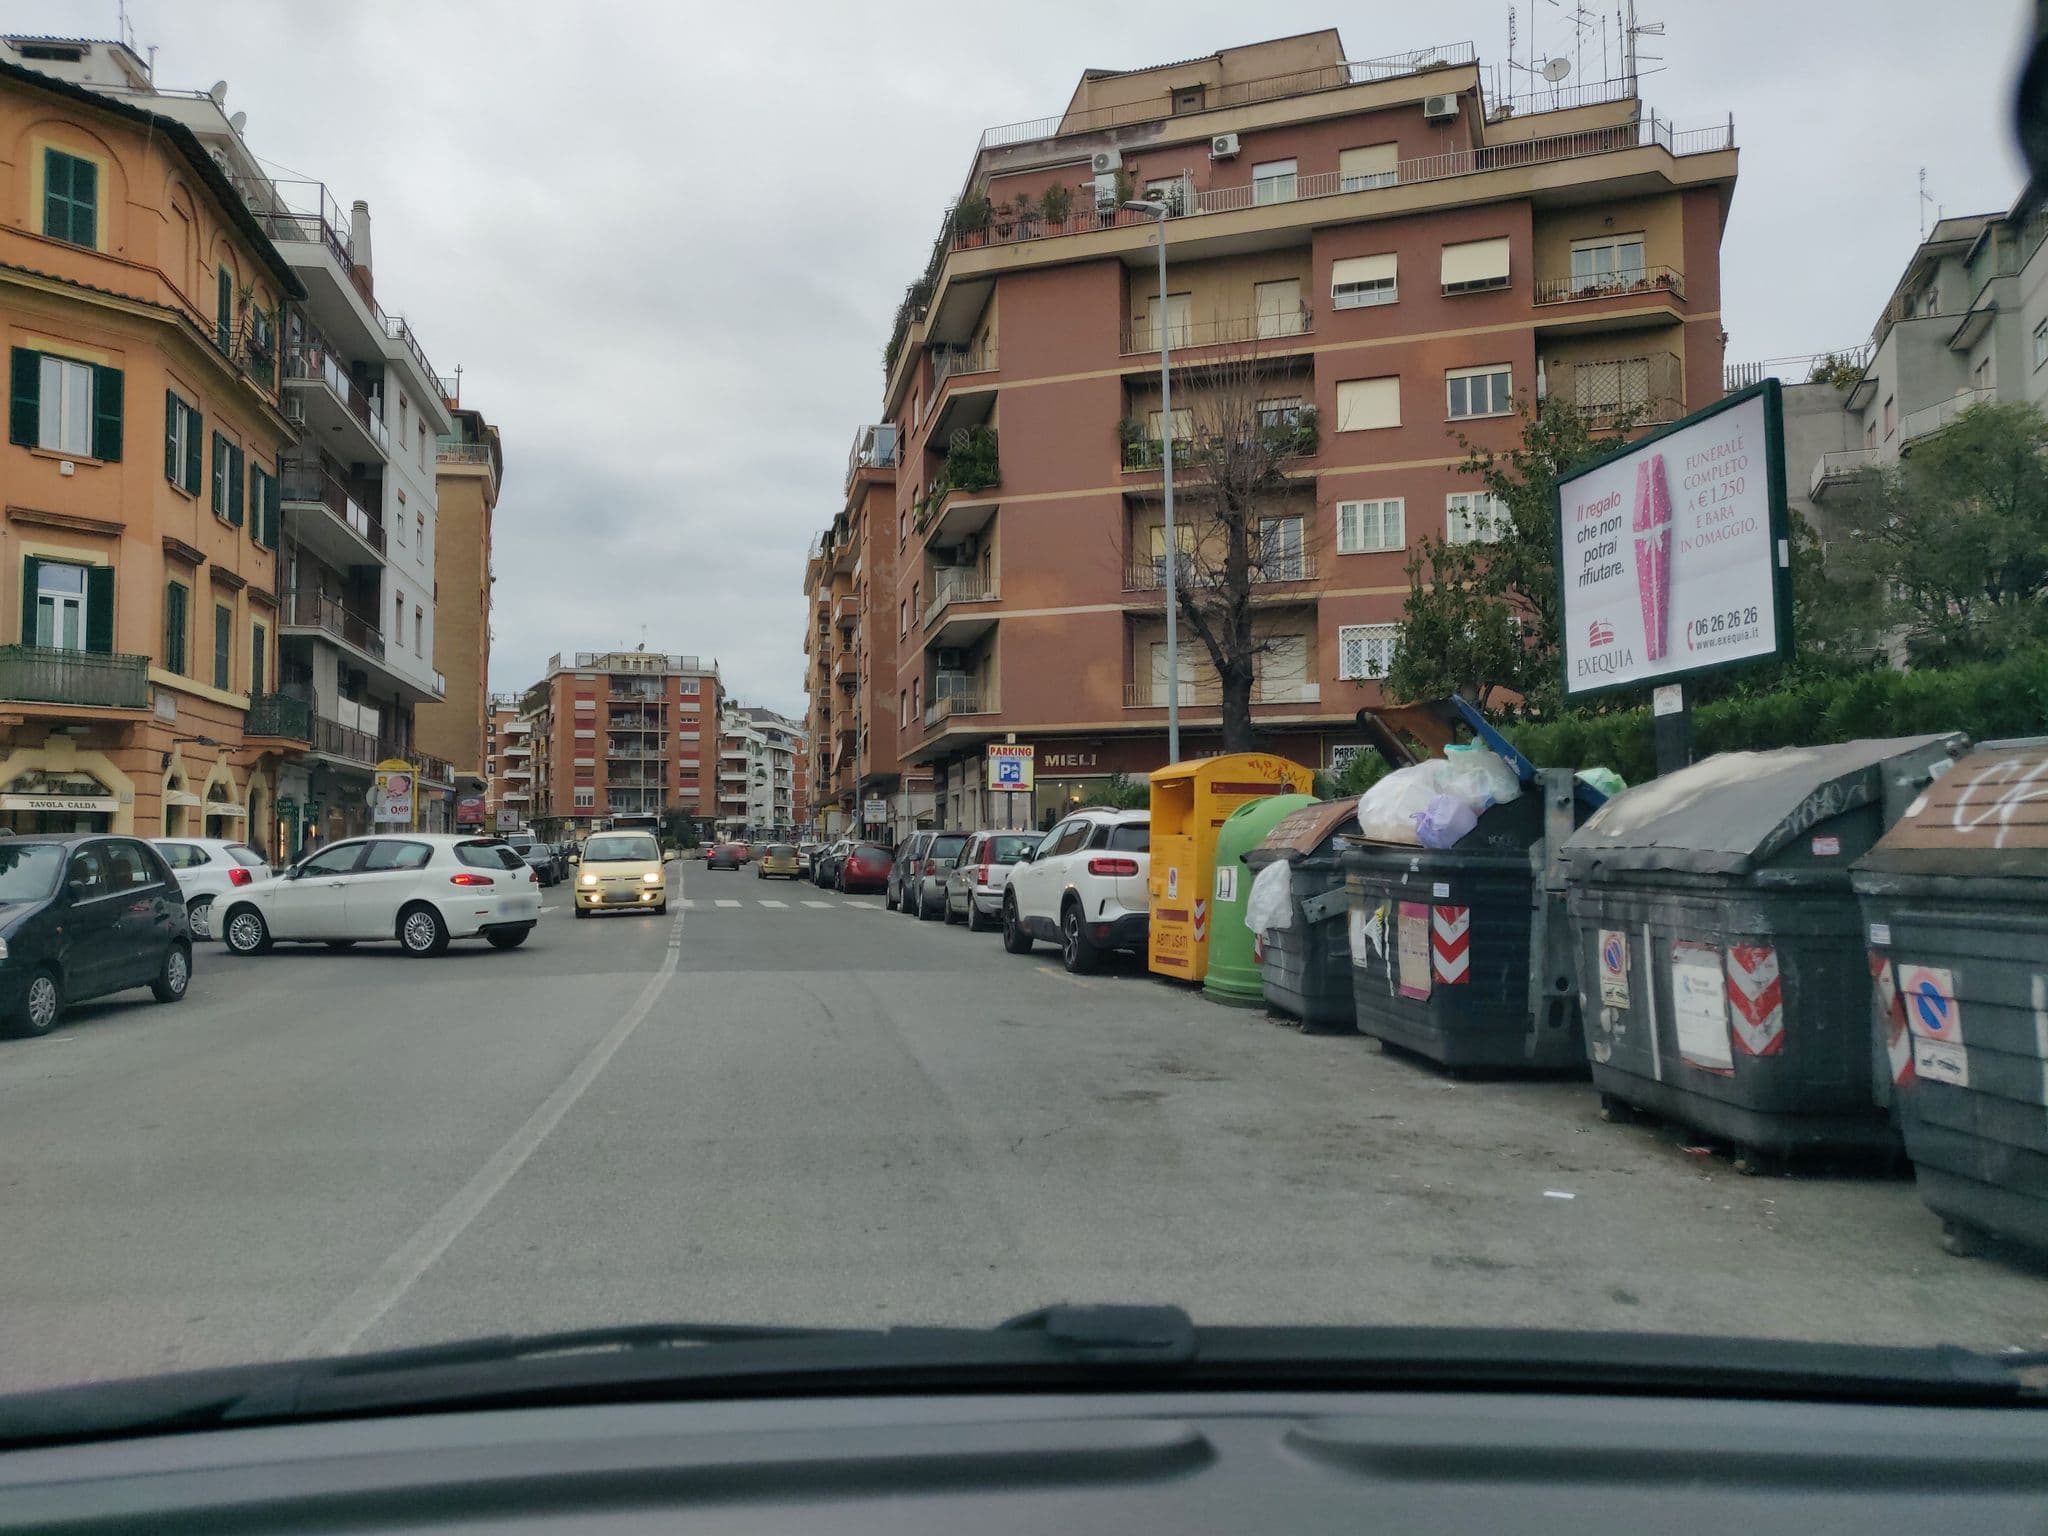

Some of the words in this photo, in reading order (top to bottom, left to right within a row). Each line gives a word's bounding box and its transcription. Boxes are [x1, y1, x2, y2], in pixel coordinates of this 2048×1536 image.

[1686, 436, 1744, 471] FUNERALE
[1684, 455, 1748, 490] COMPLETO
[1577, 504, 1584, 522] Il
[1586, 491, 1621, 519] regalo
[1697, 515, 1704, 529] E
[1706, 504, 1735, 526] BARA
[1577, 525, 1597, 544] che
[1600, 515, 1622, 536] non
[1681, 540, 1692, 553] IN
[1695, 517, 1758, 548] OMAGGIO.
[1584, 536, 1618, 568] potrai
[1579, 562, 1625, 588] rifiutare.
[1695, 618, 1708, 636] 06
[1711, 614, 1725, 632] 26
[1728, 610, 1741, 629] 26
[1744, 606, 1758, 625] 26
[1696, 627, 1759, 650] www.exequia.it
[1577, 648, 1634, 677] EXEQUIA
[990, 746, 1033, 756] PARKING
[1044, 754, 1097, 767] MIELI
[67, 801, 97, 809] CALDA
